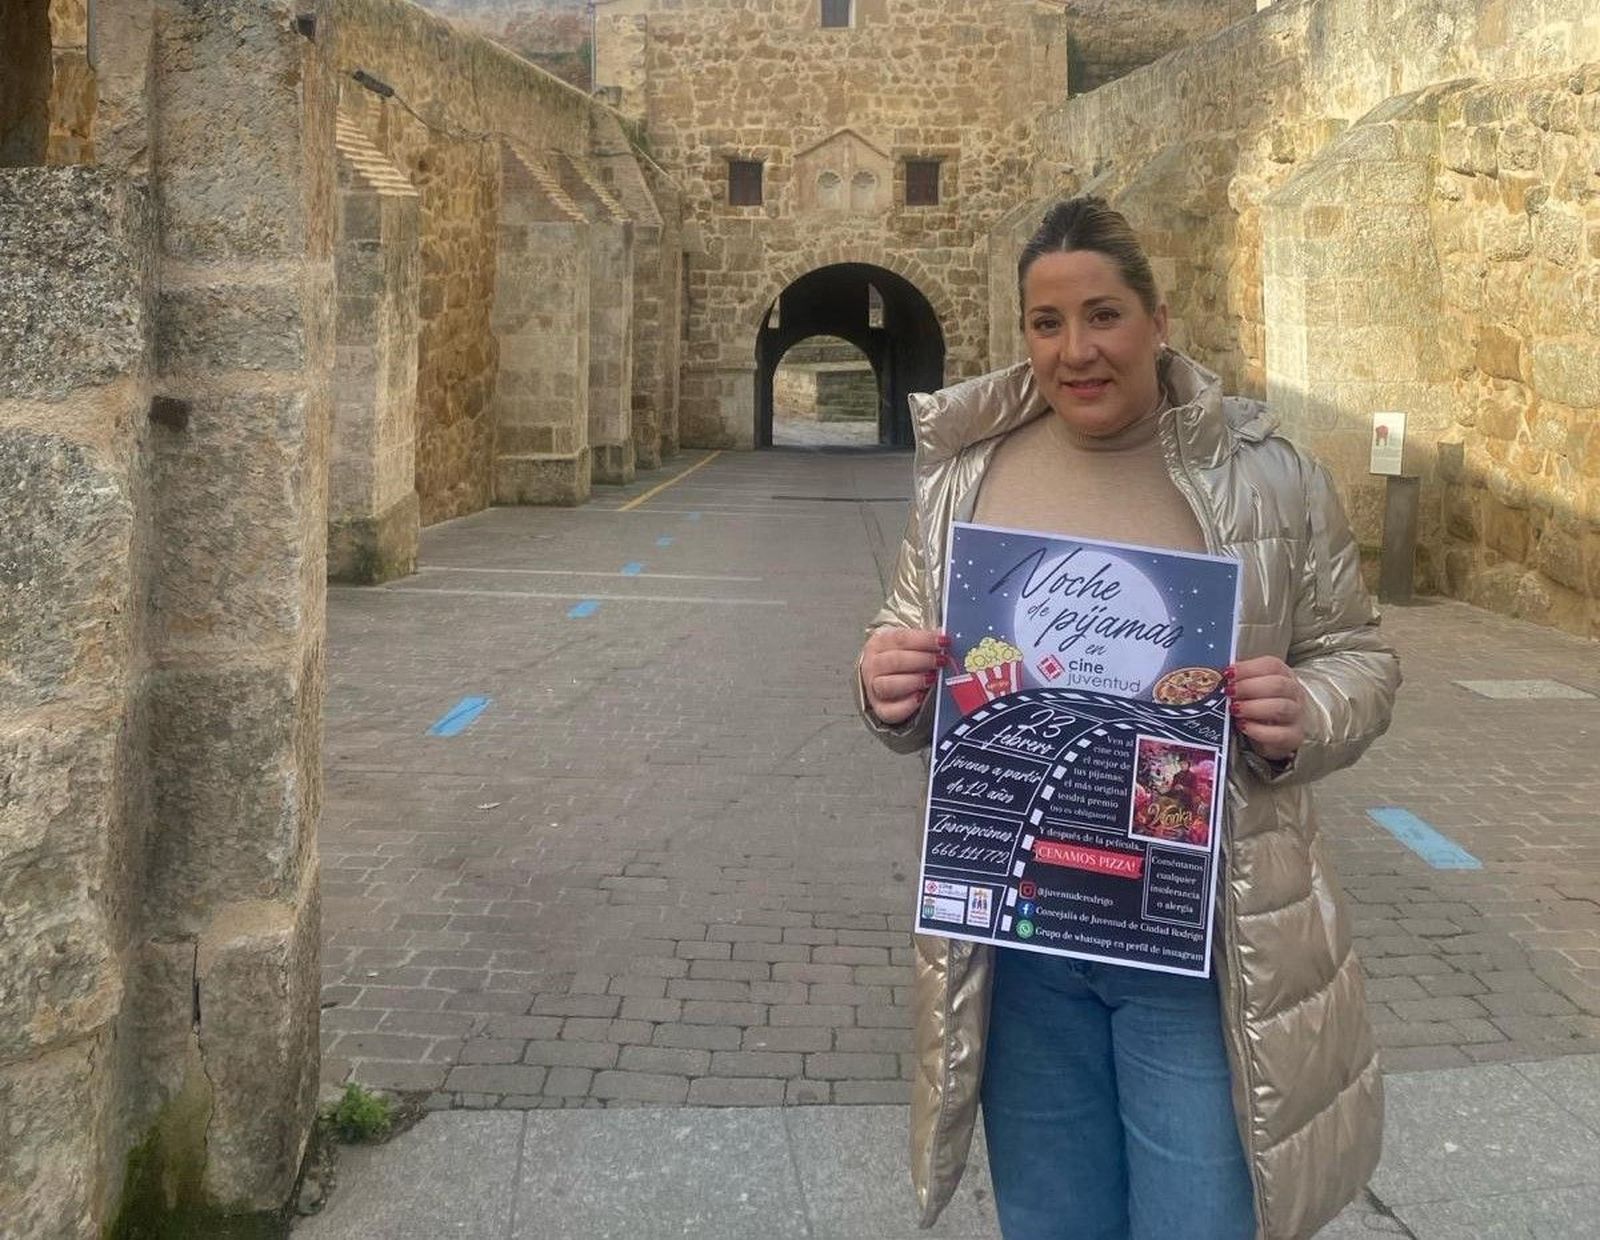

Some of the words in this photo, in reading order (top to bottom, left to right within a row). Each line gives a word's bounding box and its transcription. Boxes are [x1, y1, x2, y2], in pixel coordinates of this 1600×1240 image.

[989, 547, 1122, 601] Noche
[1027, 598, 1051, 621] de
[1085, 643, 1107, 656] en
[1068, 658, 1105, 675] cine
[1067, 671, 1142, 694] juventud
[1017, 708, 1077, 739] 23
[980, 724, 1055, 755] febrero
[1092, 758, 1119, 770] mejor
[1074, 781, 1093, 791] más
[1093, 784, 1129, 797] original
[1057, 792, 1086, 804] tendrá
[1087, 797, 1120, 809] premio
[1046, 829, 1081, 841] después
[1082, 833, 1094, 842] de
[1099, 857, 1136, 872] PIZZA!
[1151, 855, 1204, 872] Coméntanos
[1156, 872, 1197, 885] cualquier
[1164, 902, 1194, 914] alergia
[1079, 912, 1091, 922] de
[1090, 914, 1127, 929] Juventud
[1128, 920, 1139, 930] de
[1140, 922, 1170, 936] Ciudad
[1171, 927, 1204, 943] Rodrigo
[1035, 927, 1061, 940] Grupo
[1062, 930, 1073, 940] de
[1074, 934, 1112, 948] whatsapp
[1113, 940, 1126, 949] en
[1125, 942, 1149, 953] perfil
[1150, 945, 1161, 954] de
[1162, 947, 1204, 962] instagram
